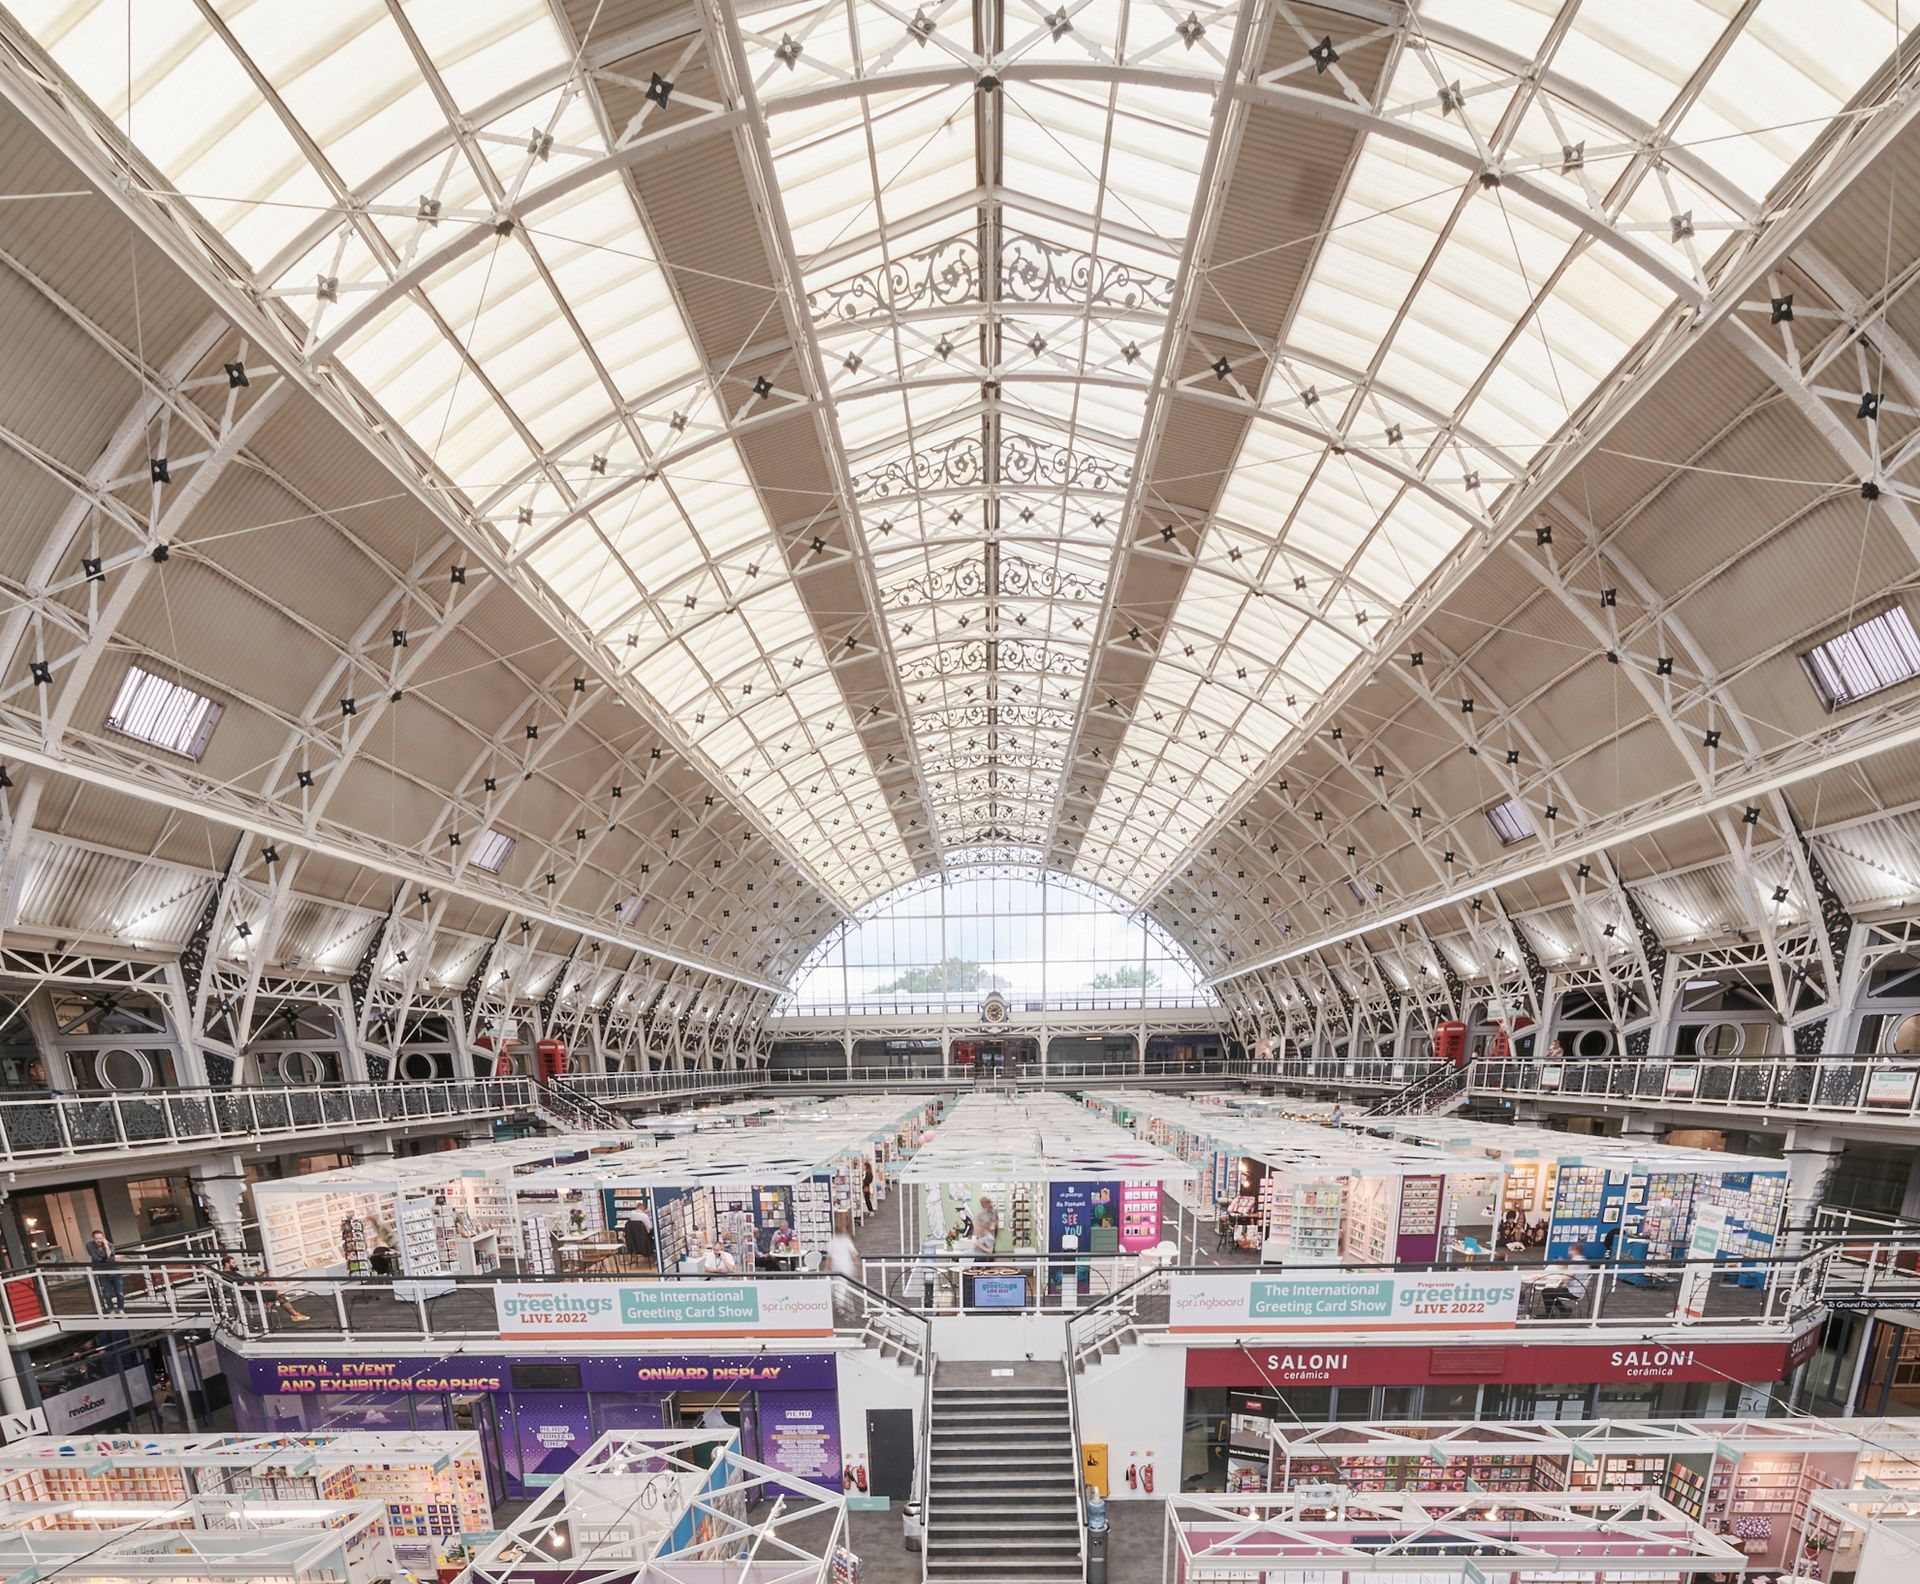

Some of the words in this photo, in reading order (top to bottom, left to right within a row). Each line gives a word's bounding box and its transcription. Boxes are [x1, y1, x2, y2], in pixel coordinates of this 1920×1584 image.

[1061, 1213, 1079, 1226] SEE
[1064, 1225, 1083, 1237] YOU
[982, 1282, 1018, 1291] greetings
[1264, 1284, 1290, 1297] The
[1292, 1282, 1380, 1296] International
[633, 1290, 658, 1303] The
[660, 1289, 744, 1303] International
[1176, 1292, 1245, 1310] springboard
[1400, 1282, 1515, 1307] greetings
[503, 1293, 613, 1316] greetings
[762, 1296, 828, 1314] springboard
[1255, 1300, 1313, 1316] Greeting
[1315, 1299, 1347, 1313] Card
[1349, 1299, 1387, 1313] Show
[1414, 1303, 1448, 1315] LIVE
[1450, 1302, 1485, 1314] 2022
[521, 1312, 553, 1324] LIVE
[555, 1312, 588, 1323] 2022
[627, 1306, 684, 1322] Greeting
[685, 1306, 716, 1319] Card
[718, 1305, 753, 1318] Show
[1267, 1354, 1348, 1370] SALONI
[1610, 1350, 1694, 1366] SALONI
[342, 1363, 396, 1377] EVENT
[638, 1367, 709, 1381] ONWARD
[712, 1367, 781, 1381] DISPLAY
[1283, 1370, 1330, 1380] cerámica
[1626, 1367, 1673, 1376] cerámica
[280, 1379, 316, 1393] AND
[320, 1378, 413, 1392] EXHIBITION
[415, 1377, 501, 1391] GRAPHICS
[68, 1398, 106, 1418] revolution
[12, 1414, 37, 1435] M
